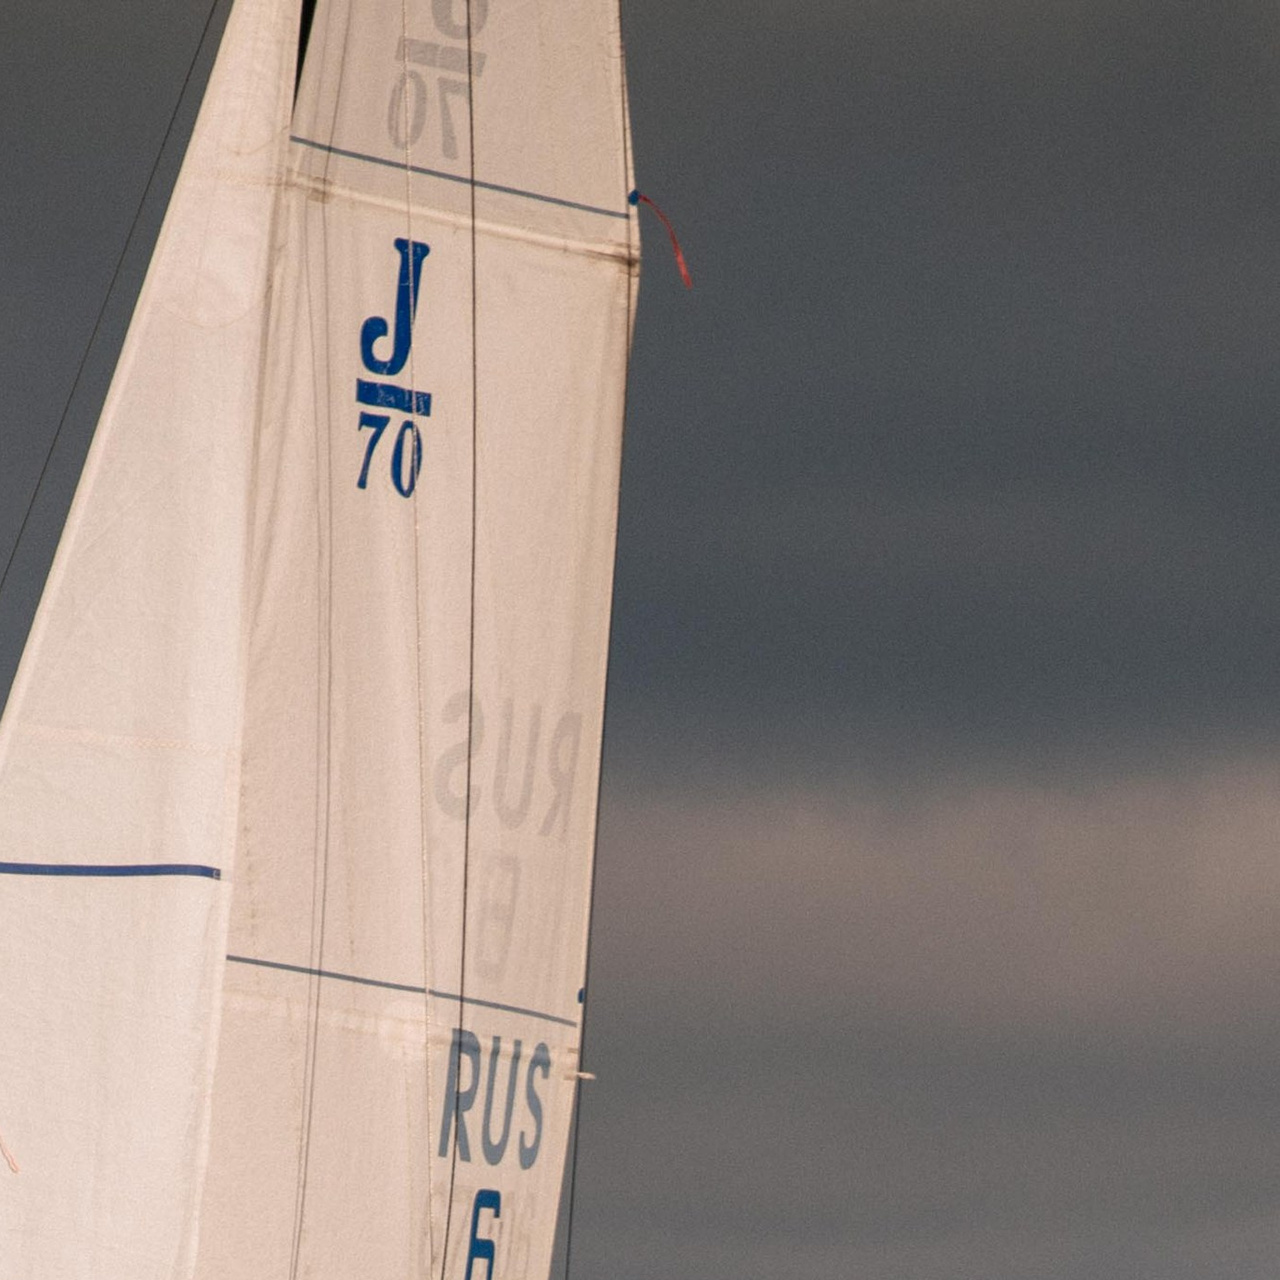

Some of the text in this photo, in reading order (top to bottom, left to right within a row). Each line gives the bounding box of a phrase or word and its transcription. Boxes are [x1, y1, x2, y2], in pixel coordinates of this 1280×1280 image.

[360, 237, 431, 377] J
[357, 410, 423, 499] 70
[437, 1027, 552, 1171] RUS
